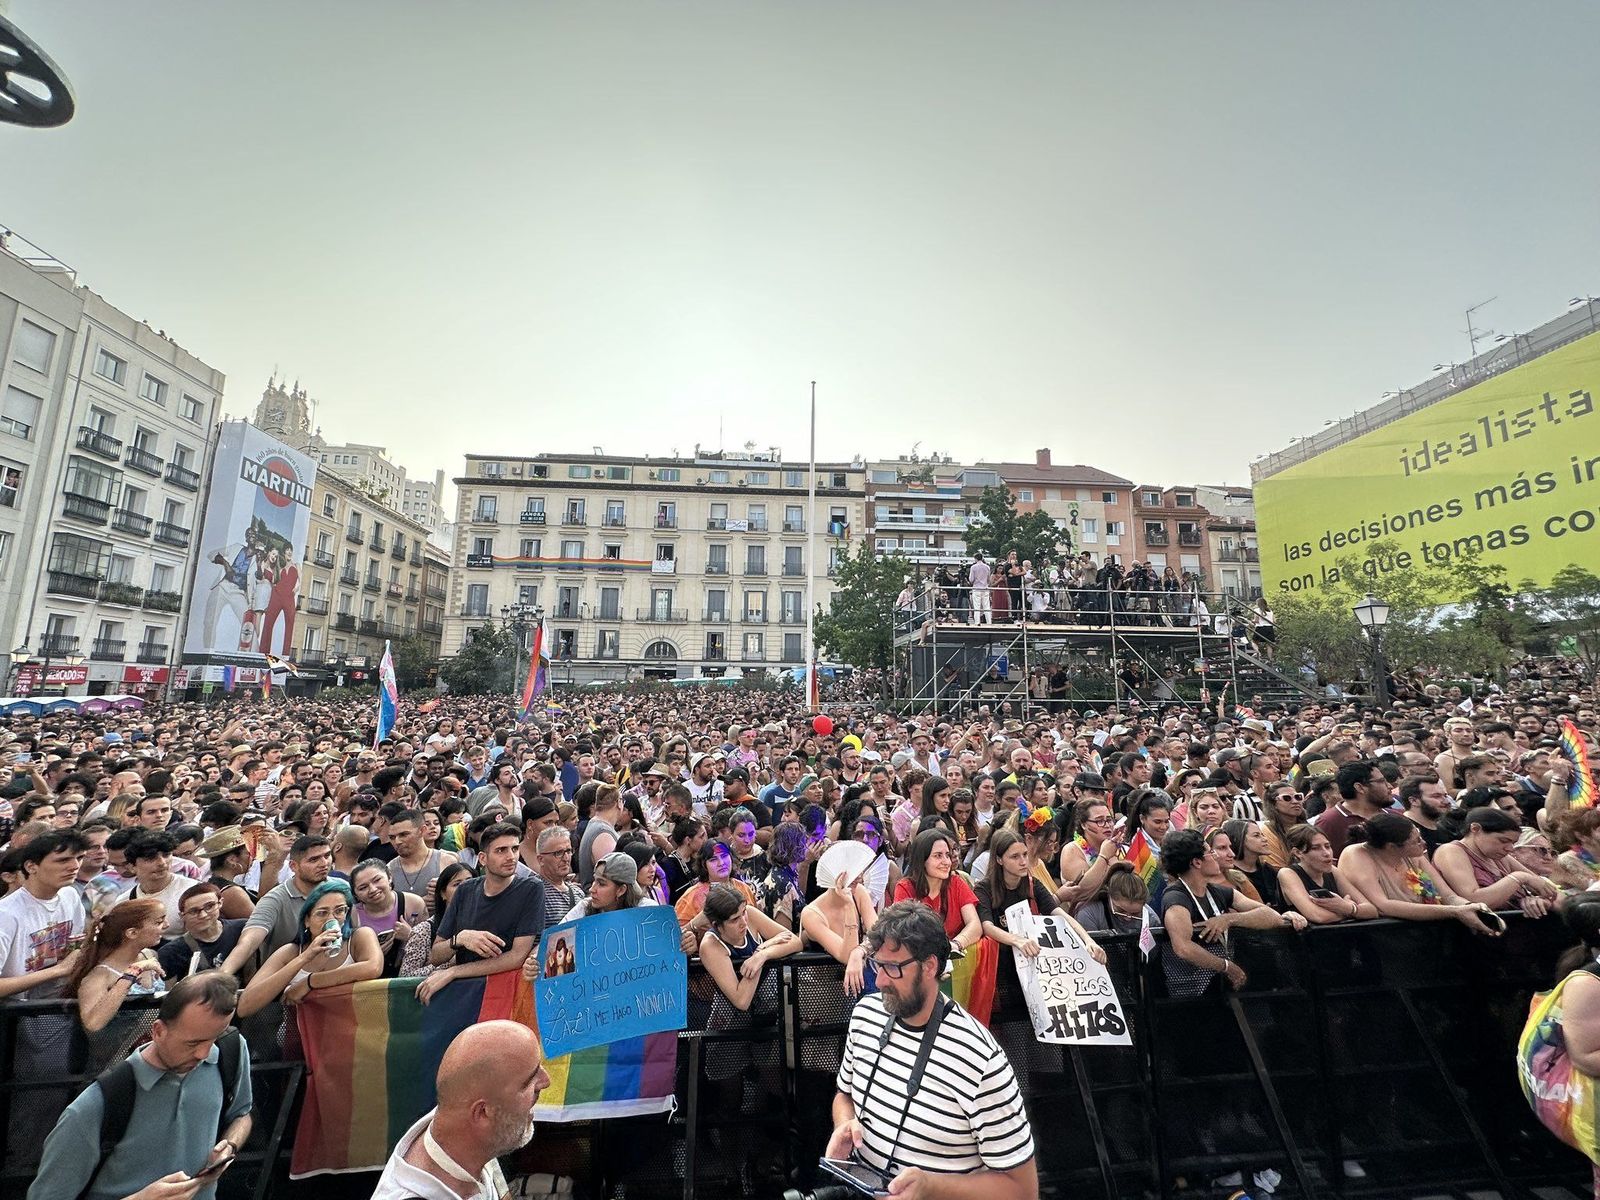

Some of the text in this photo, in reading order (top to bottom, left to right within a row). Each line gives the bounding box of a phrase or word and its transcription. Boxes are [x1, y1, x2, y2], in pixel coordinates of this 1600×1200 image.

[1399, 389, 1593, 477] idealista
[243, 460, 311, 505] MARTINI
[1283, 542, 1312, 562] las
[1319, 499, 1462, 552] decisiones
[1474, 471, 1557, 511] más
[1279, 507, 1600, 593] son la que tomas co
[592, 975, 609, 994] NO
[613, 964, 656, 987] CONOZCO
[658, 960, 669, 974] A
[1074, 976, 1112, 996] LOS
[594, 1011, 610, 1028] ME
[612, 1005, 632, 1021] HAGO
[1046, 1001, 1126, 1040] HITOS
